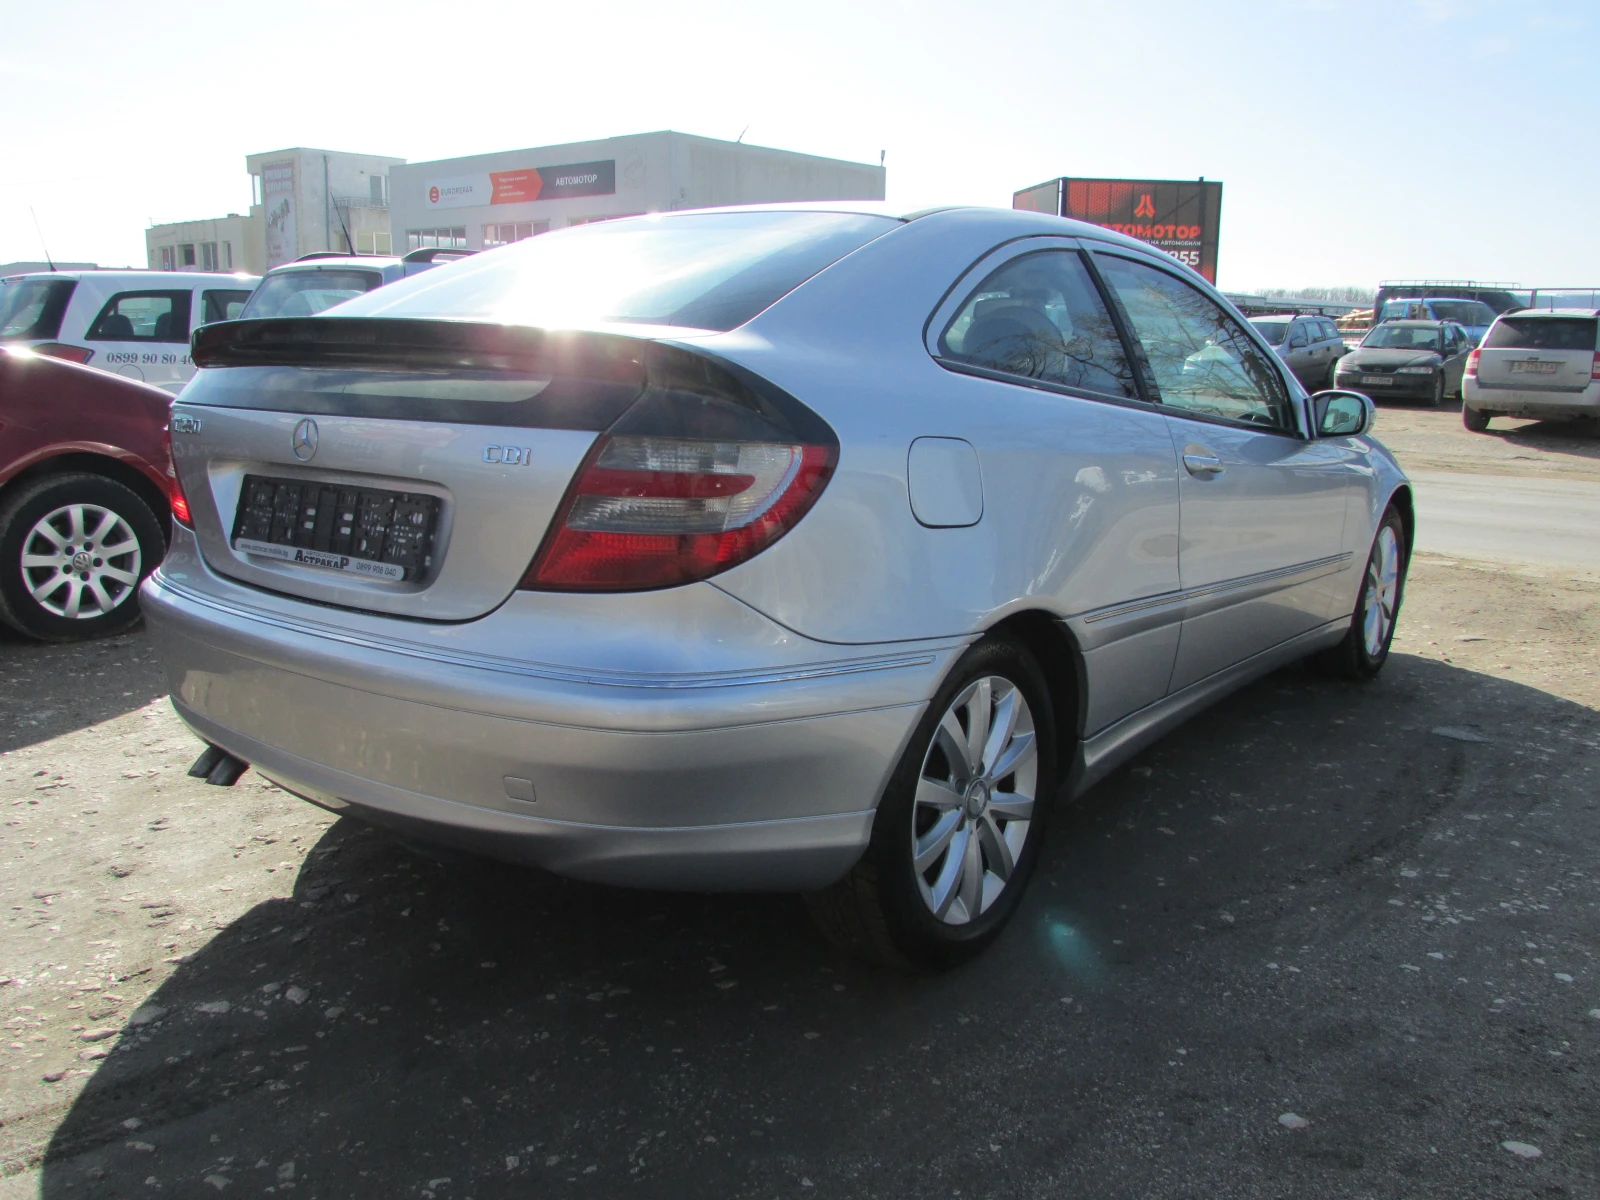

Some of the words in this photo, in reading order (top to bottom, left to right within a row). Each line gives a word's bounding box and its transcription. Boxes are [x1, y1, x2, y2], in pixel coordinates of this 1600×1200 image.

[555, 174, 598, 187] АВТОМОТОР
[1100, 223, 1201, 238] ТОМОТОР
[107, 352, 138, 364] 0899
[142, 353, 158, 364] 90
[161, 353, 177, 365] 80
[482, 444, 532, 467] CDI
[356, 562, 372, 572] 0899
[384, 569, 397, 577] 040
